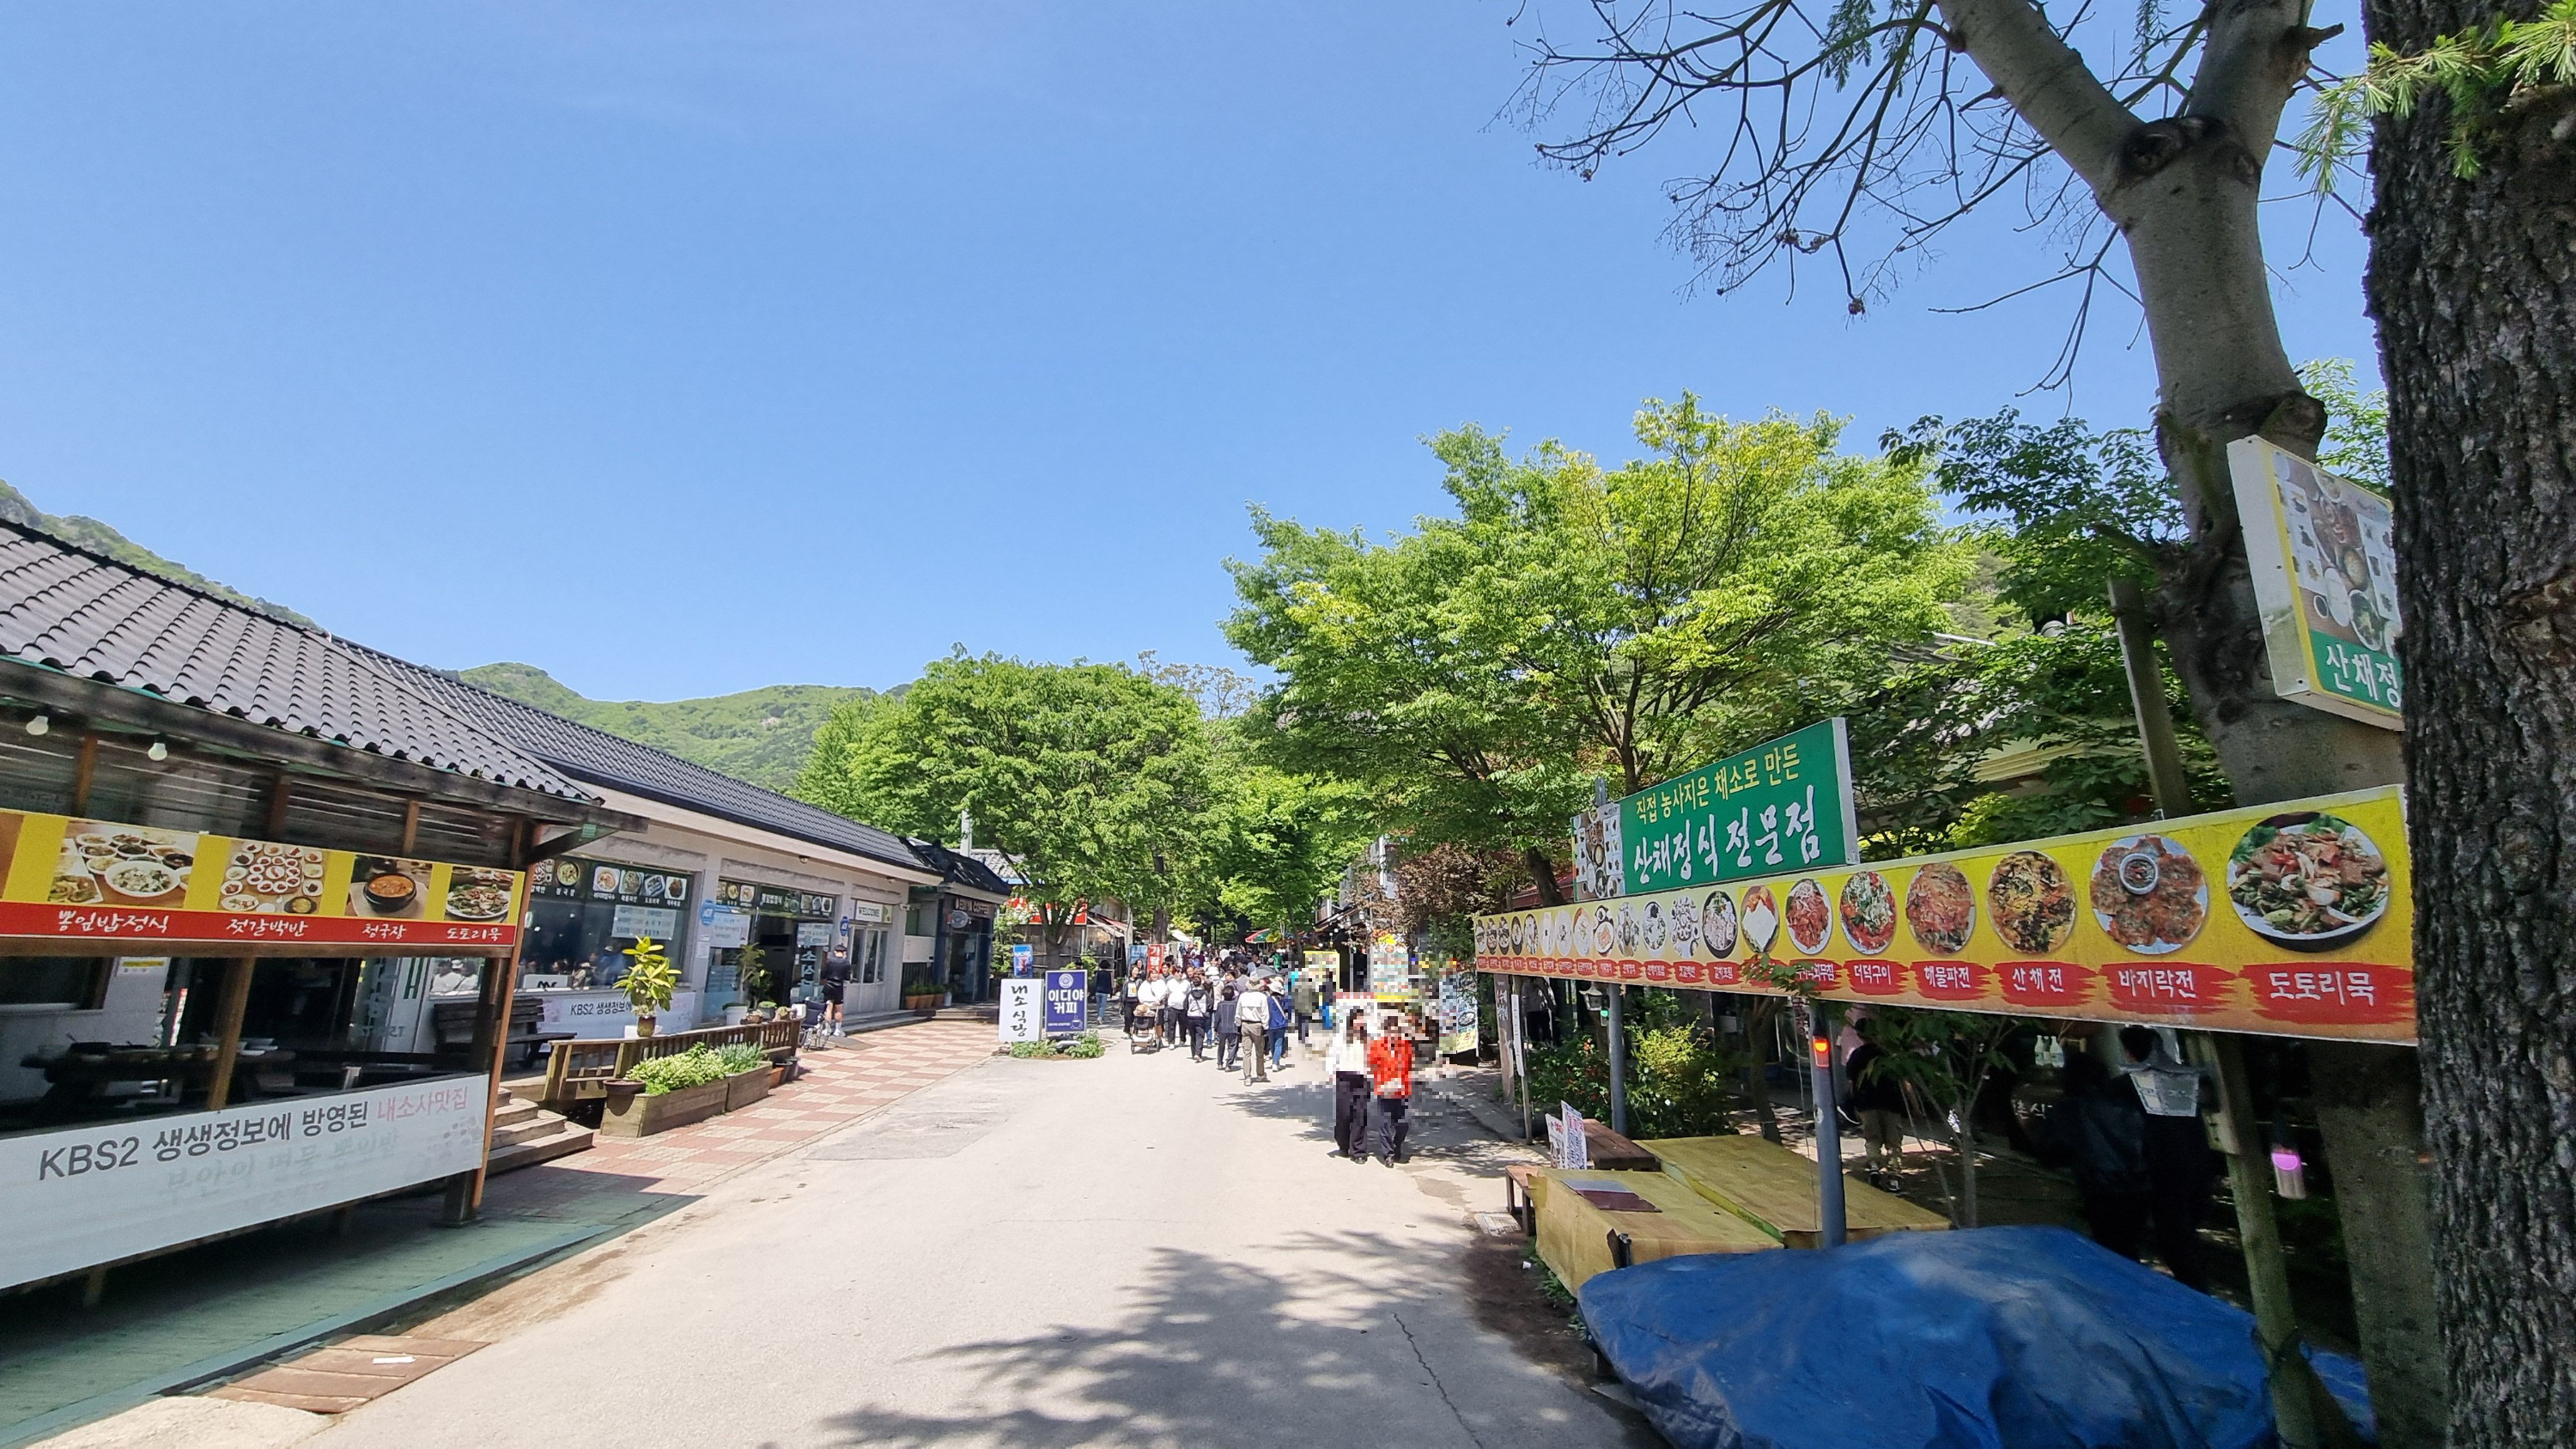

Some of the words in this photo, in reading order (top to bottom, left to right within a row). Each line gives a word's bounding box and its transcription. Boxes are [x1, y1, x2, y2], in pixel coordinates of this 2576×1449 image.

[2326, 644, 2402, 708] 산채정
[1636, 795, 1657, 825] 직접
[1660, 776, 1710, 819] 농사지은
[1715, 759, 1760, 801] 채소로
[1765, 742, 1801, 787] 만든
[1633, 813, 1718, 885] 산채정식
[1725, 784, 1821, 868] 전문점
[58, 910, 169, 934] 뽕잎밥정식
[226, 918, 309, 937] 젓갈백반
[362, 922, 407, 941] 청국장
[447, 928, 503, 941] 도토리묵
[1854, 964, 1892, 985] 더덕구이
[1923, 965, 1971, 989] 해물파전
[2117, 969, 2196, 1000] 바지락전
[1048, 989, 1084, 1002] 이디야
[2269, 970, 2375, 1007] 도토리묵
[570, 1003, 594, 1016] KBS2
[1054, 1002, 1078, 1014] 커피
[39, 1135, 140, 1181] KBS2
[151, 1111, 293, 1163] 생생정보에
[301, 1100, 369, 1138] 방영된
[376, 1085, 469, 1122] 내소사맛집
